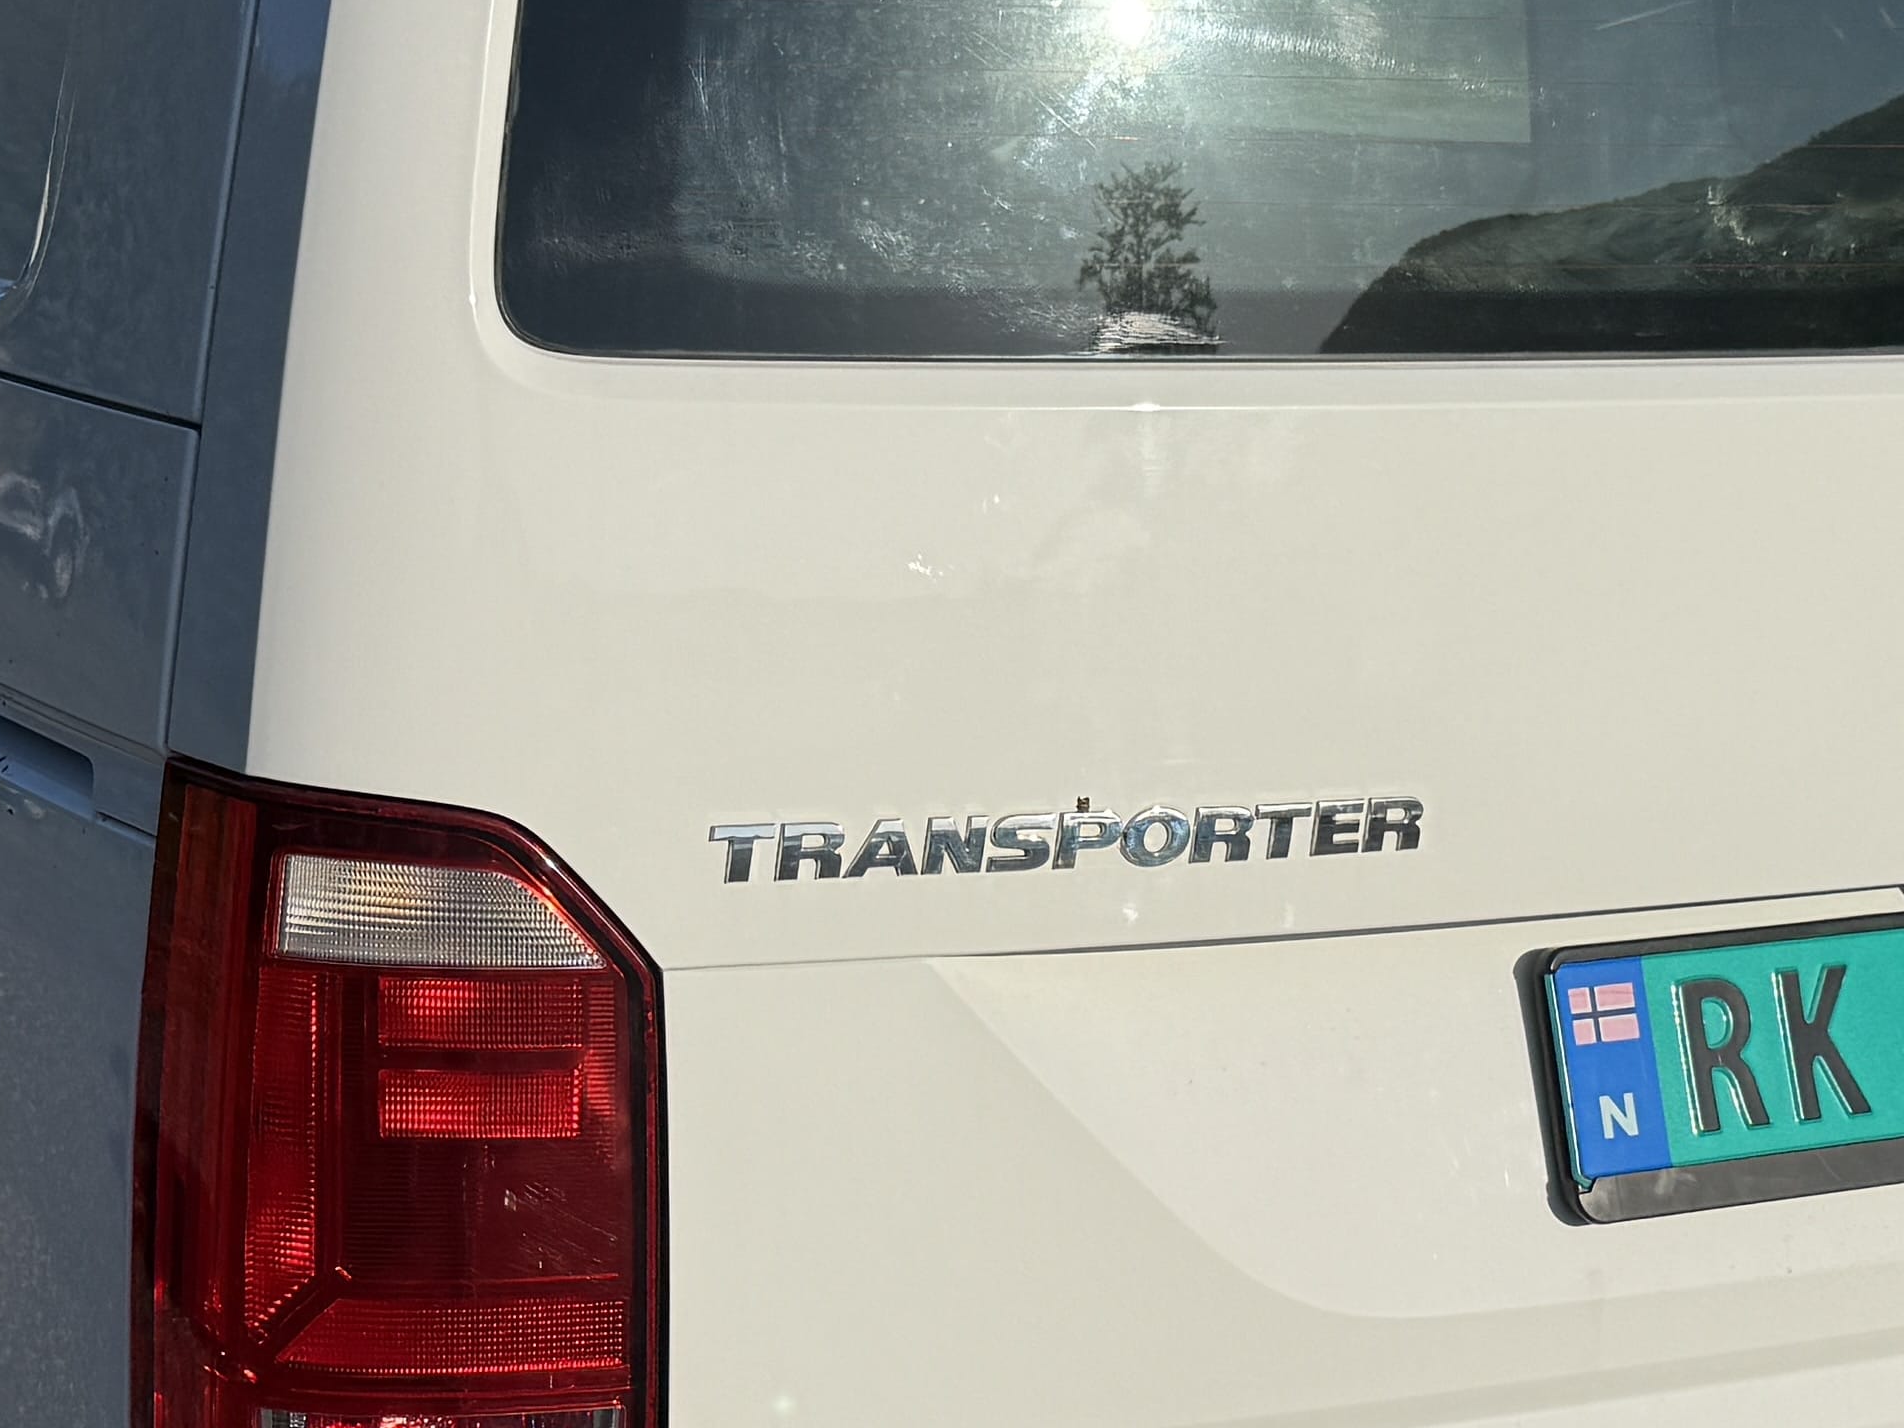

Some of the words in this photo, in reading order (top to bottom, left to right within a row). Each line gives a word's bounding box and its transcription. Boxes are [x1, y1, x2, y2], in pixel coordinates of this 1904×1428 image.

[708, 796, 1424, 884] TRANSPORTER
[1672, 962, 1872, 1136] RK
[1600, 1091, 1639, 1141] N
